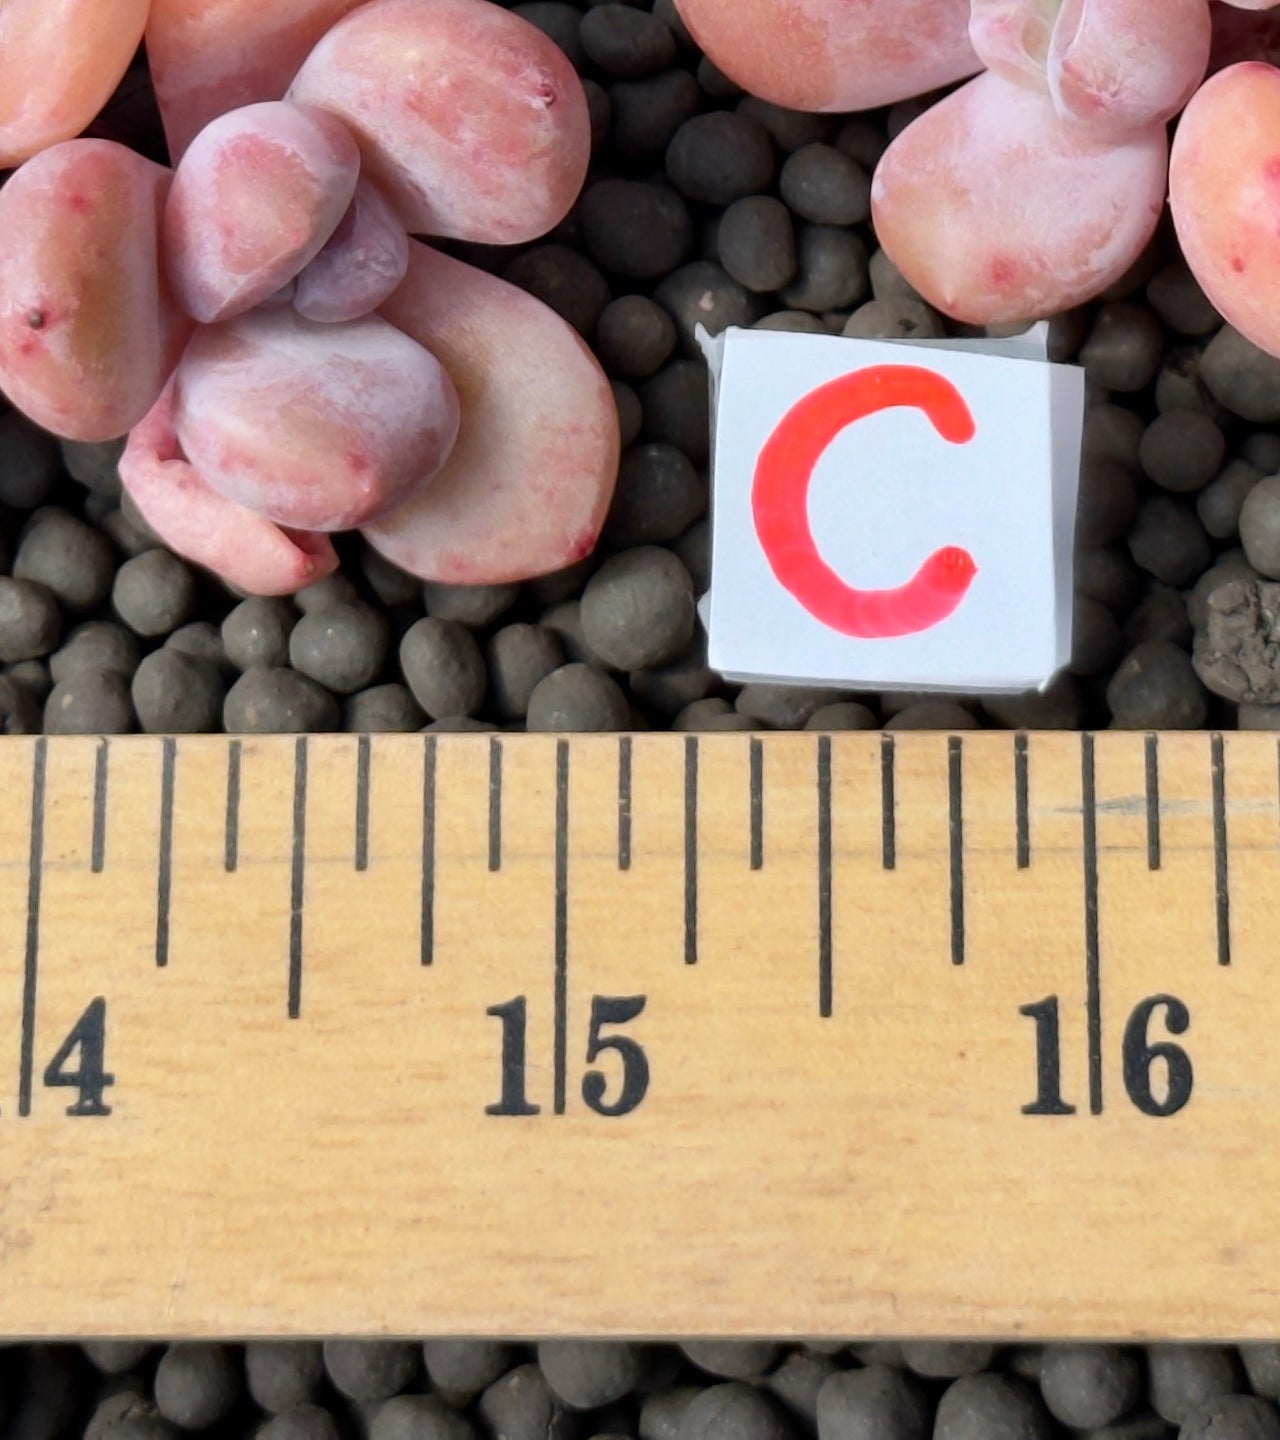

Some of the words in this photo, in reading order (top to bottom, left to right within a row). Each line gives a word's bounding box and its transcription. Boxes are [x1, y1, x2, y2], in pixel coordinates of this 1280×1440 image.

[750, 363, 980, 640] C
[485, 995, 650, 1117] 15
[1019, 994, 1194, 1118] 16
